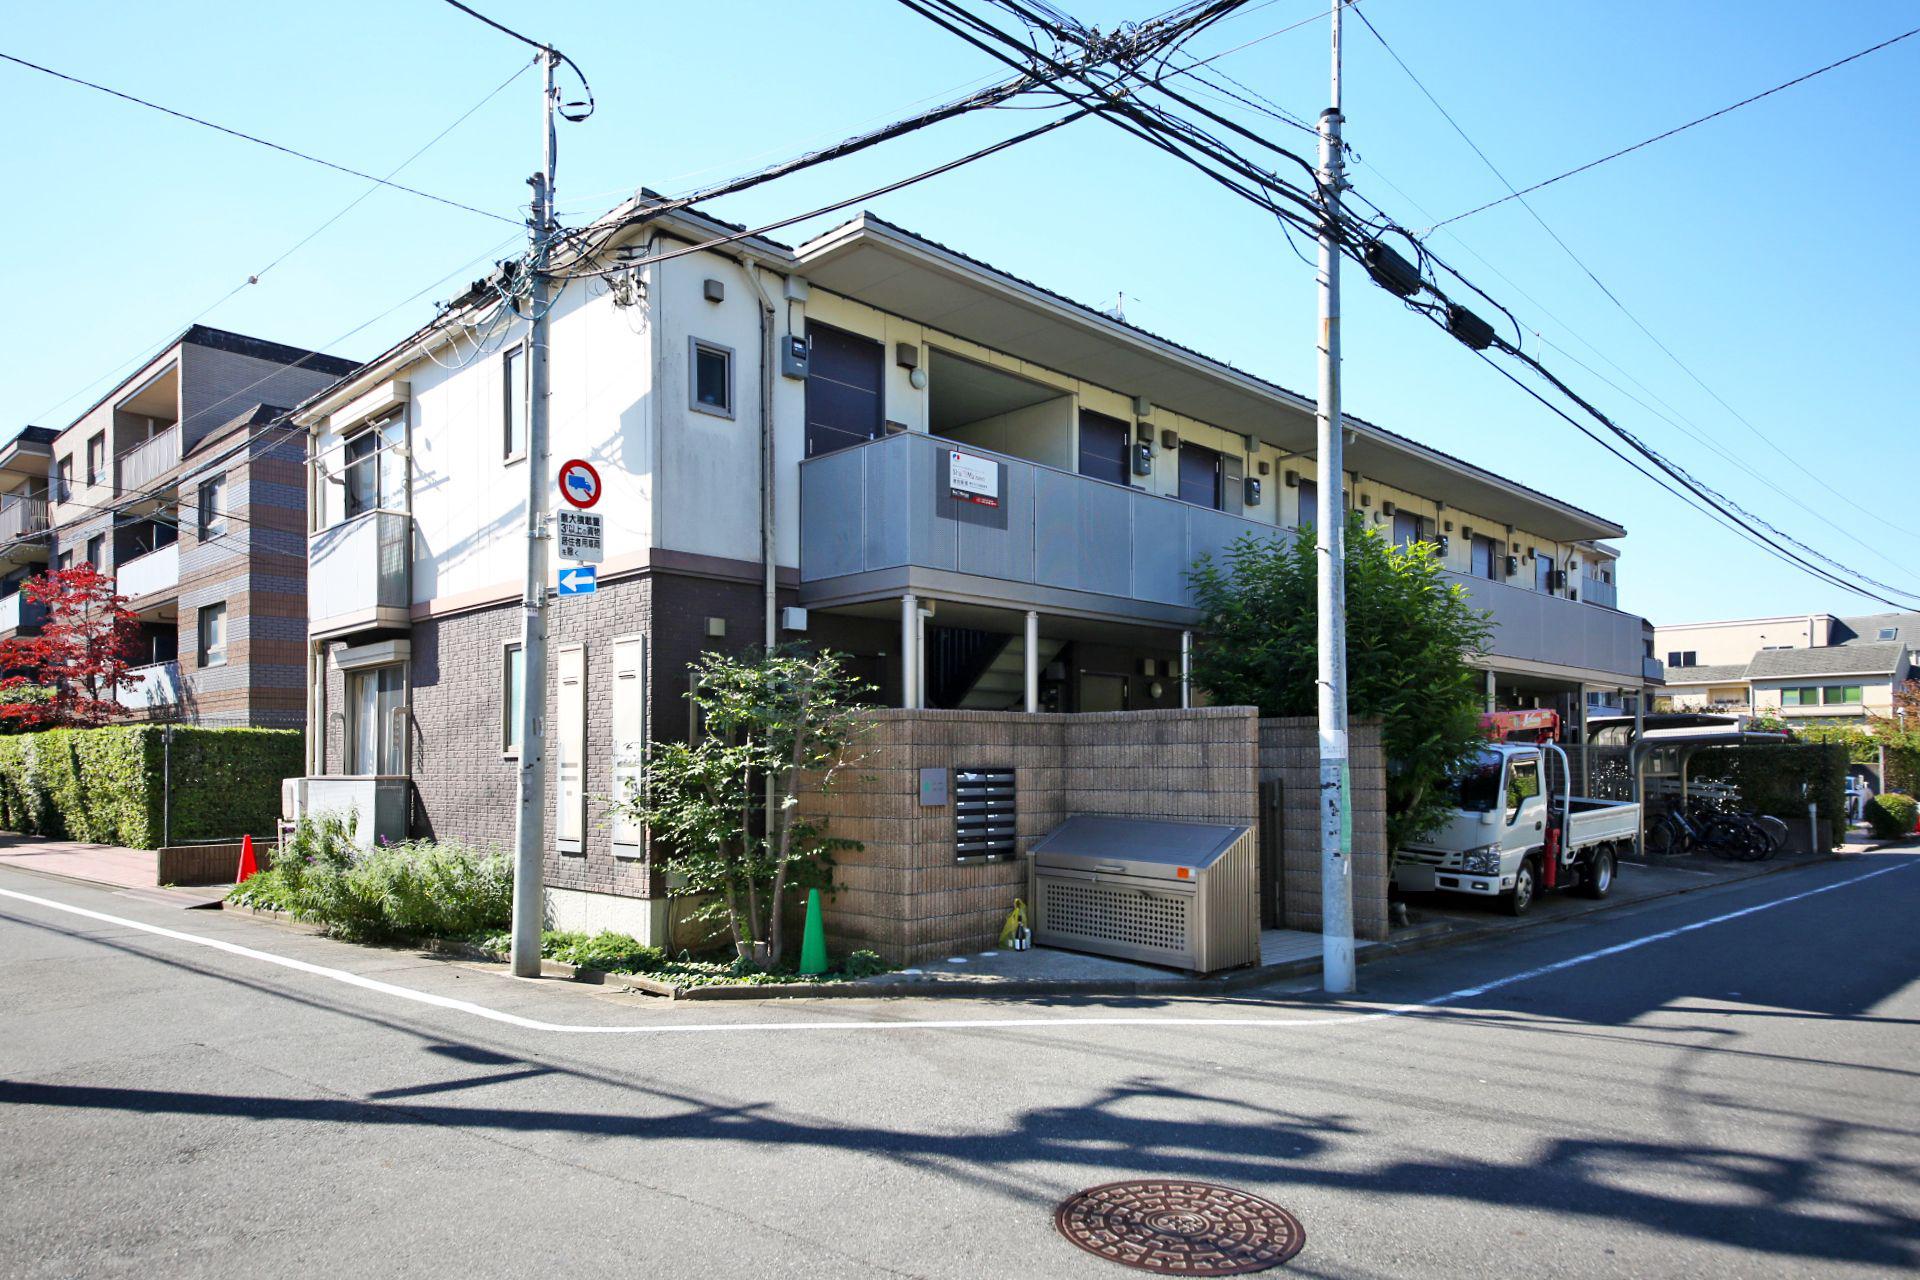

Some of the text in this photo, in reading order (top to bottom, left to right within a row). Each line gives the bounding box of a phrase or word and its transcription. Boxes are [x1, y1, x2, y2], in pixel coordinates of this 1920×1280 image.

[560, 513, 600, 526] 最大積載量
